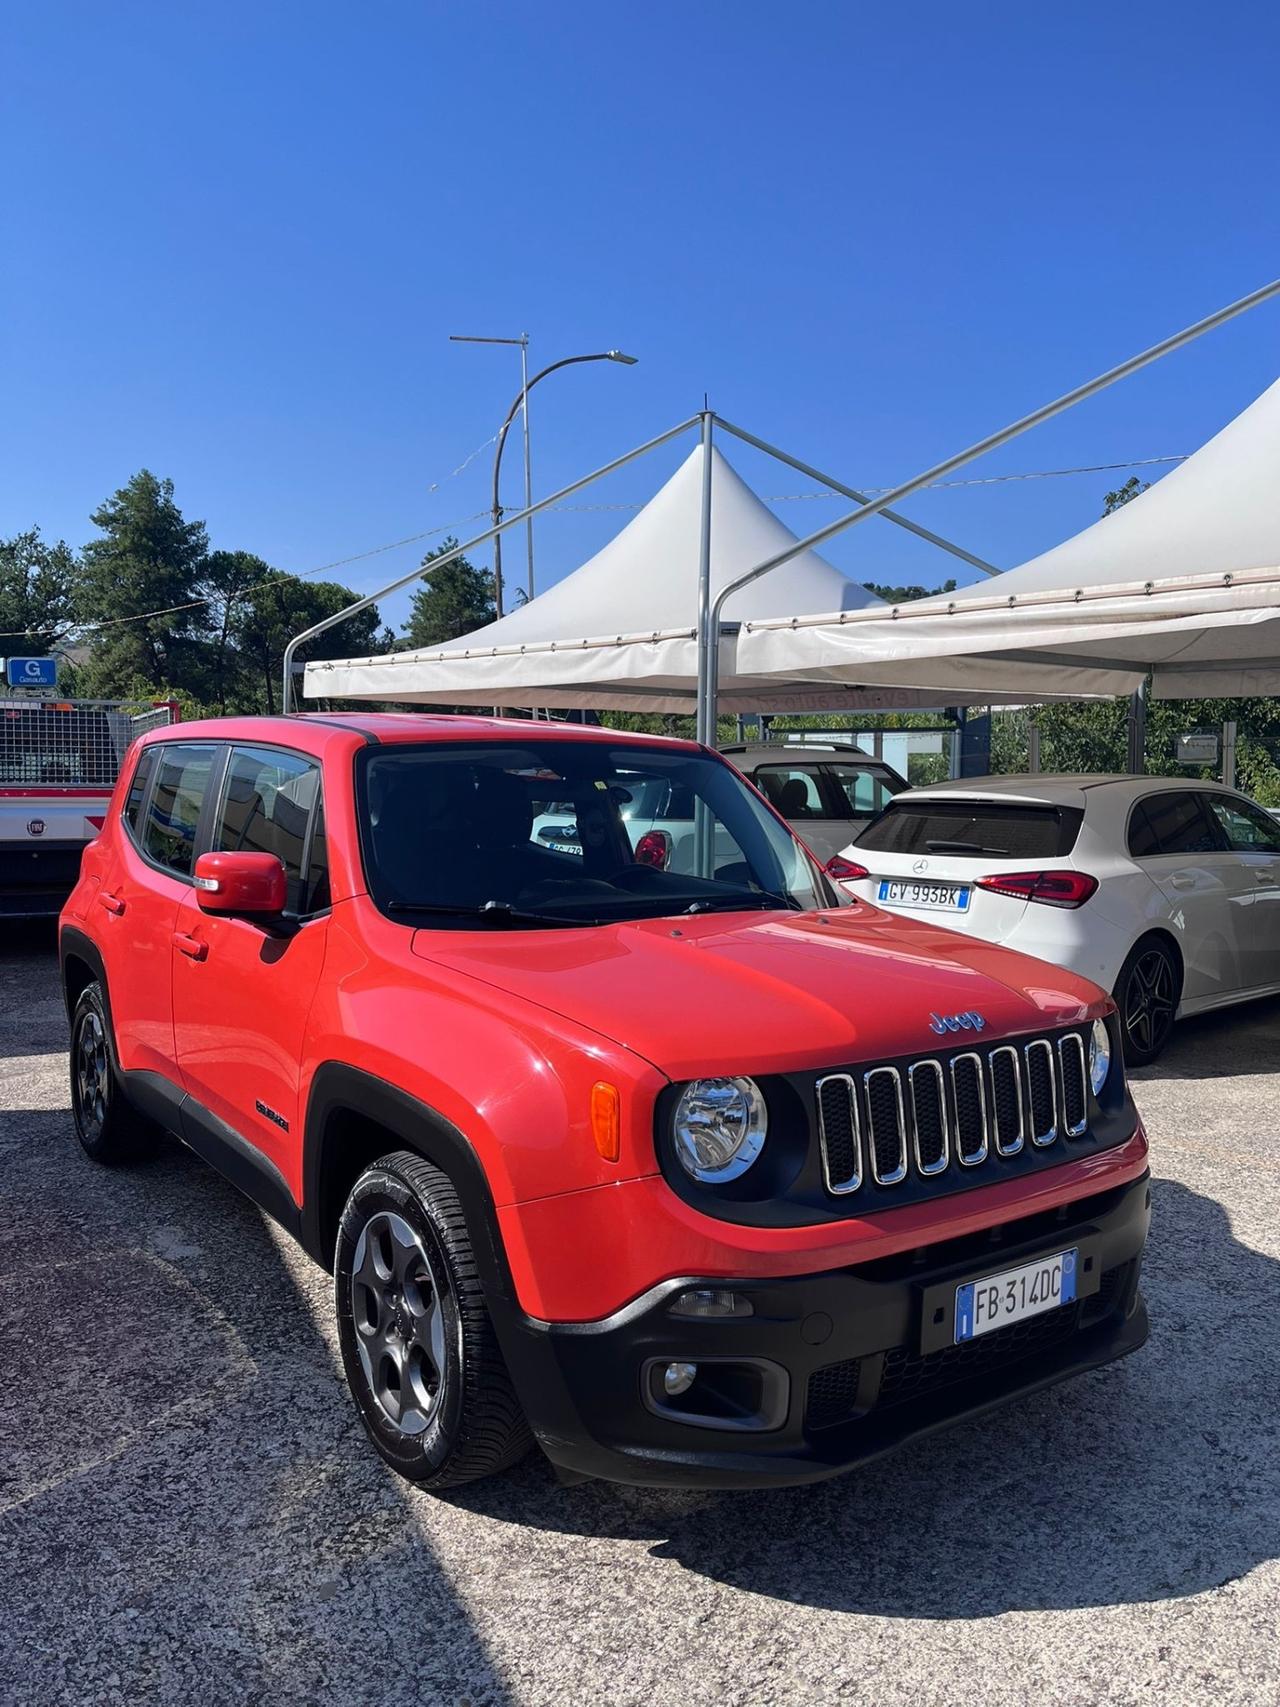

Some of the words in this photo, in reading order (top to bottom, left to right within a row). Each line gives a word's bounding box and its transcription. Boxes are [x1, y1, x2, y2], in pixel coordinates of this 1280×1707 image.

[25, 661, 40, 676] G
[889, 882, 908, 900] GV
[911, 884, 959, 905] 993BK
[928, 1010, 986, 1035] Jeep
[976, 1286, 999, 1325] FB
[1005, 1265, 1061, 1314] 314DC
